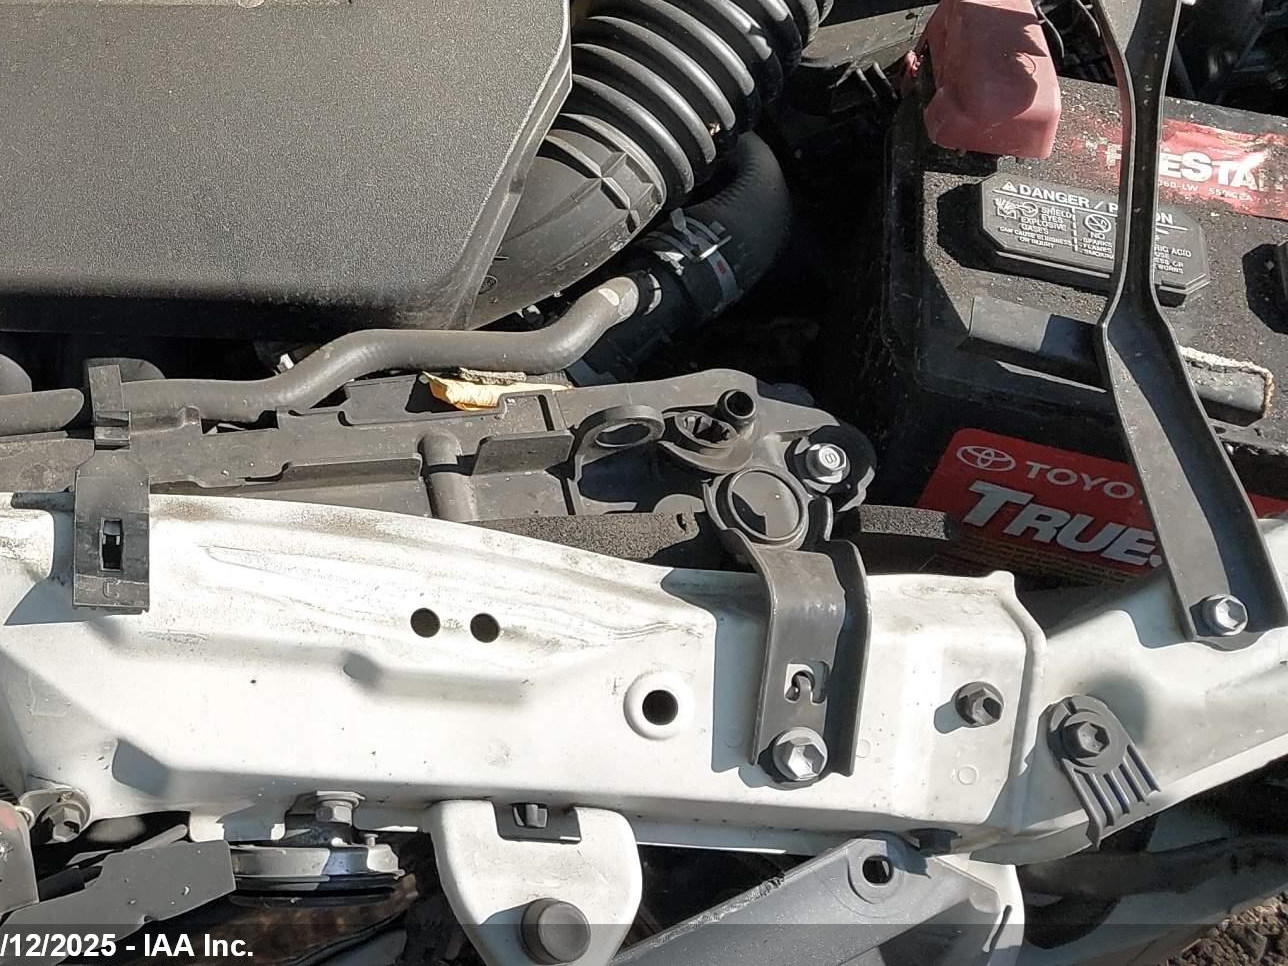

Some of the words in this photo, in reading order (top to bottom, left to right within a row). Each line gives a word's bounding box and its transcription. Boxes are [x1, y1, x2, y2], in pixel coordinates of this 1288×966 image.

[1019, 184, 1090, 208] DANGER
[1041, 206, 1072, 218] SHIELD
[1042, 214, 1064, 224] EYES
[1090, 232, 1106, 241] NO
[962, 480, 1163, 569] TRUE
